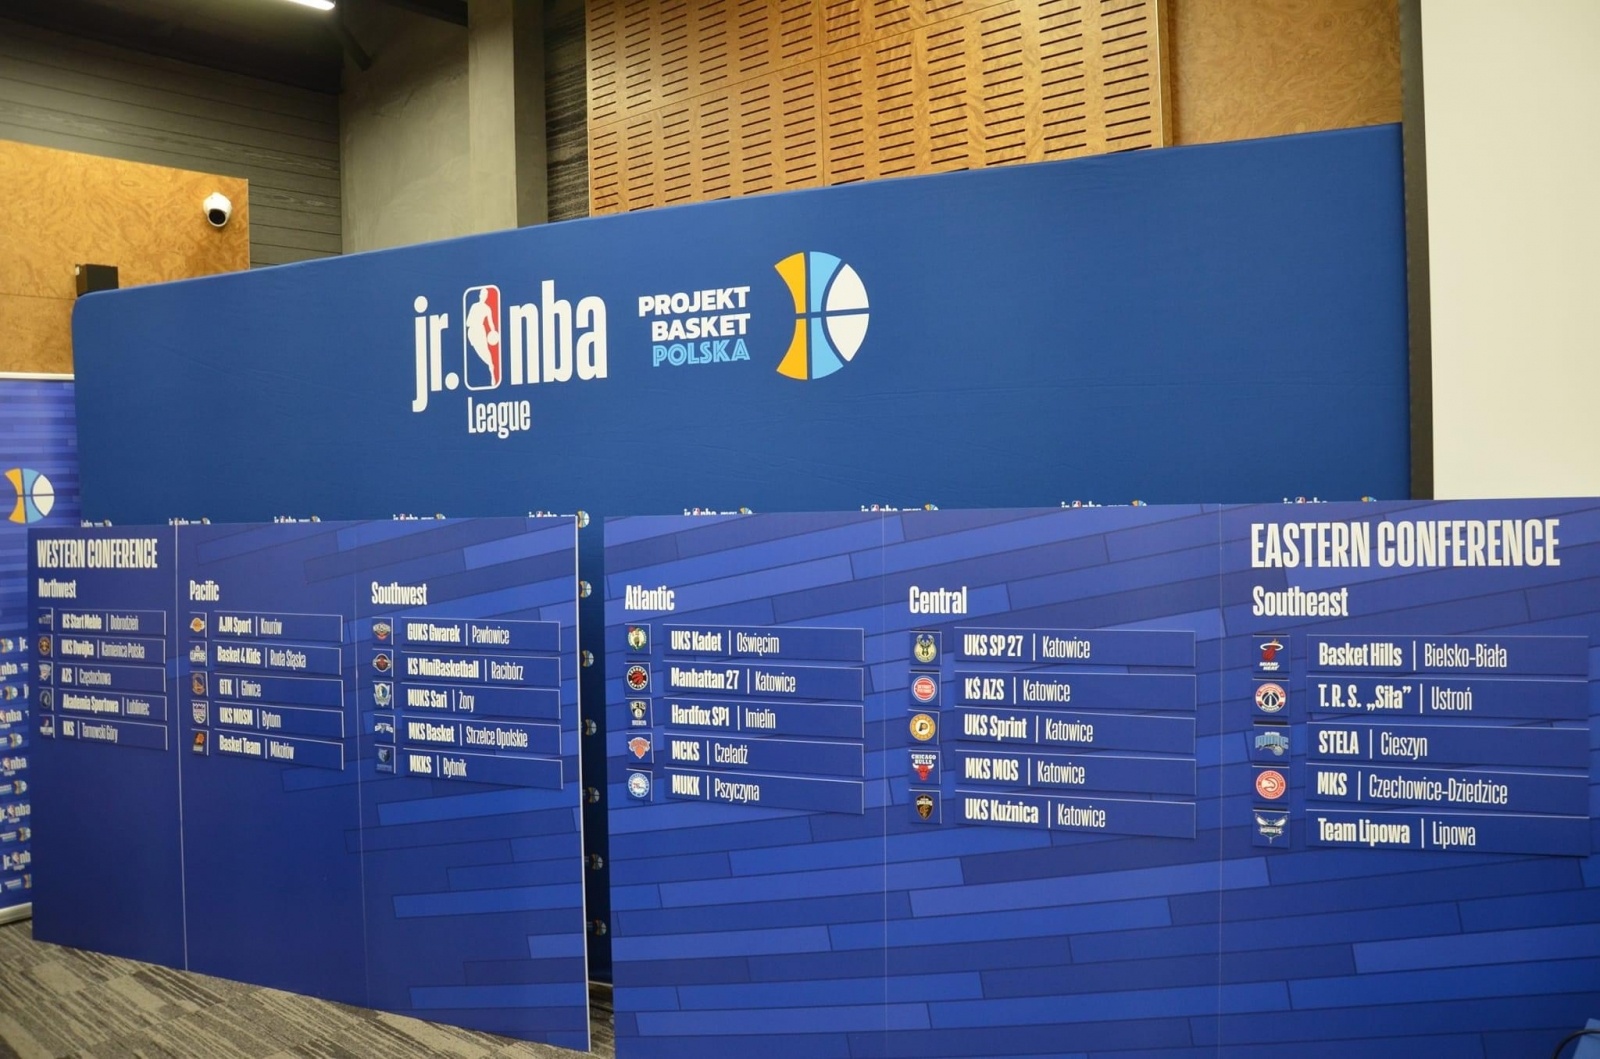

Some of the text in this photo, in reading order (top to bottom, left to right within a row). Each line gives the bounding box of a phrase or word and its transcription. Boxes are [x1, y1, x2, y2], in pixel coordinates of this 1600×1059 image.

[638, 286, 750, 318] PROJEKT
[652, 313, 750, 342] BASKET
[412, 279, 607, 412] jr. nba
[652, 338, 750, 367] POLSKA
[467, 397, 531, 439] League
[37, 539, 158, 569] WESTERN CONFERENCE
[1251, 518, 1561, 568] EASTERN CONFERENCE
[38, 578, 76, 598] Northwest
[190, 580, 219, 601] Pacific
[372, 582, 427, 605] Southwest
[625, 584, 675, 611] Atlantic
[909, 586, 967, 615] Central
[1252, 586, 1349, 617] Southeast
[233, 617, 252, 634] Sport
[407, 623, 428, 641] GUKS
[429, 624, 460, 643] Gwarek
[472, 626, 510, 644] Pawłowice
[128, 643, 145, 659] Polska
[671, 631, 780, 656] UKS Kadet Oświęcim
[964, 634, 1090, 659] UKS SP 27 Katowice
[1318, 642, 1507, 668] Basket Hills Bielsko-Biała
[218, 646, 240, 662] Basket
[240, 648, 245, 663] 4
[246, 648, 261, 664] Kids
[271, 650, 285, 666] Ruda
[286, 649, 306, 670] Śląska
[408, 658, 524, 680] KS MiniBasketball Racibórz
[61, 668, 72, 683] AZS
[219, 679, 261, 697] GTK Gliwice
[671, 667, 724, 689] Manhattan
[726, 669, 739, 690] 27
[755, 671, 796, 693] Katowice
[408, 689, 474, 712] MUKS Sari Żory
[983, 678, 1004, 700] AZS
[1023, 680, 1071, 702] Katowice
[1318, 684, 1331, 707] T.
[1332, 684, 1346, 708] R.
[1348, 685, 1362, 709] S.
[1431, 686, 1473, 711] Ustroń
[63, 694, 90, 710] Akademia
[91, 696, 119, 713] Sportowa
[671, 704, 776, 729] Hardfox SP1 Imielin
[220, 708, 233, 723] UKS
[262, 711, 281, 729] Bytom
[964, 714, 1093, 743] UKS Sprint Katowice
[219, 735, 242, 753] Basket
[243, 738, 261, 755] Team
[409, 722, 426, 740] MKS
[426, 723, 455, 742] Basket
[466, 725, 495, 746] Strzelce
[496, 728, 528, 749] Opolskie
[1318, 731, 1359, 754] STELA
[1380, 732, 1428, 760] Cieszyn
[672, 740, 748, 764] MCKS Czeladź
[410, 755, 467, 778] MKKS Rybnik
[965, 758, 1085, 785] MKS MOS Katowice
[672, 775, 700, 796] MUKK
[715, 778, 760, 803] Pszyczyna
[1317, 772, 1347, 796] MKS
[1369, 775, 1508, 805] Czechowice-Dziedzice
[965, 799, 1106, 828] UKS Kuźnica Katowice
[1318, 818, 1476, 847] Team Lipowa Lipowa
